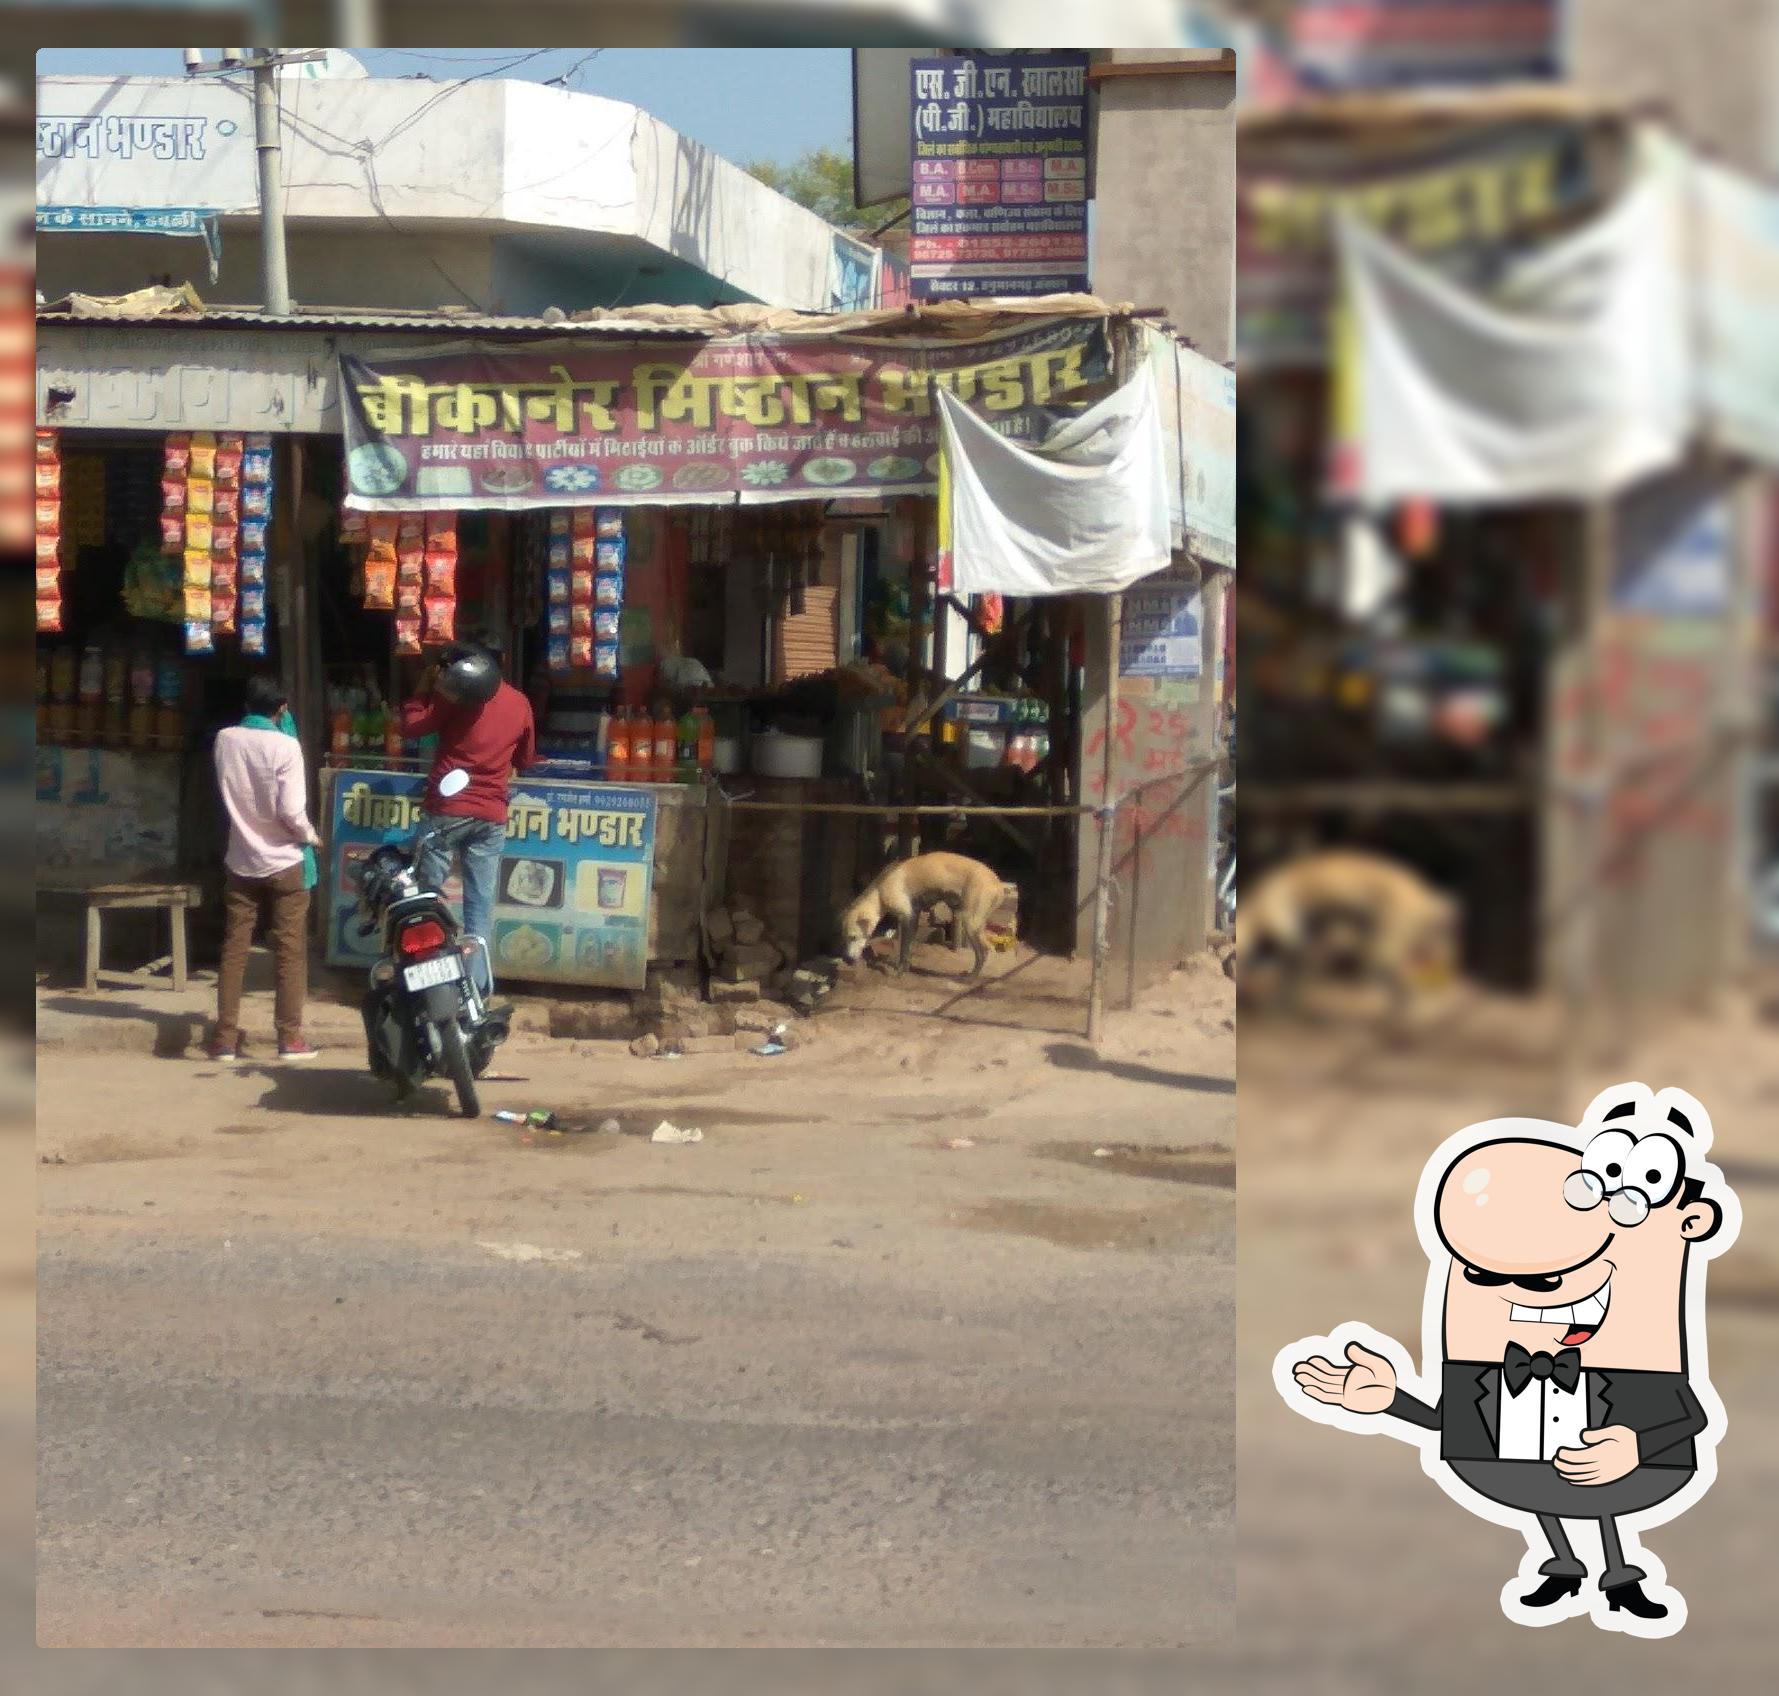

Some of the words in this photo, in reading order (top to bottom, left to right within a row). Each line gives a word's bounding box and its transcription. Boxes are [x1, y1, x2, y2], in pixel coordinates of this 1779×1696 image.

[987, 100, 1083, 130] महाविद्यालय
[106, 115, 207, 160] भण्डार
[356, 364, 620, 436] बीकानेर
[556, 807, 647, 847] भण्डार
